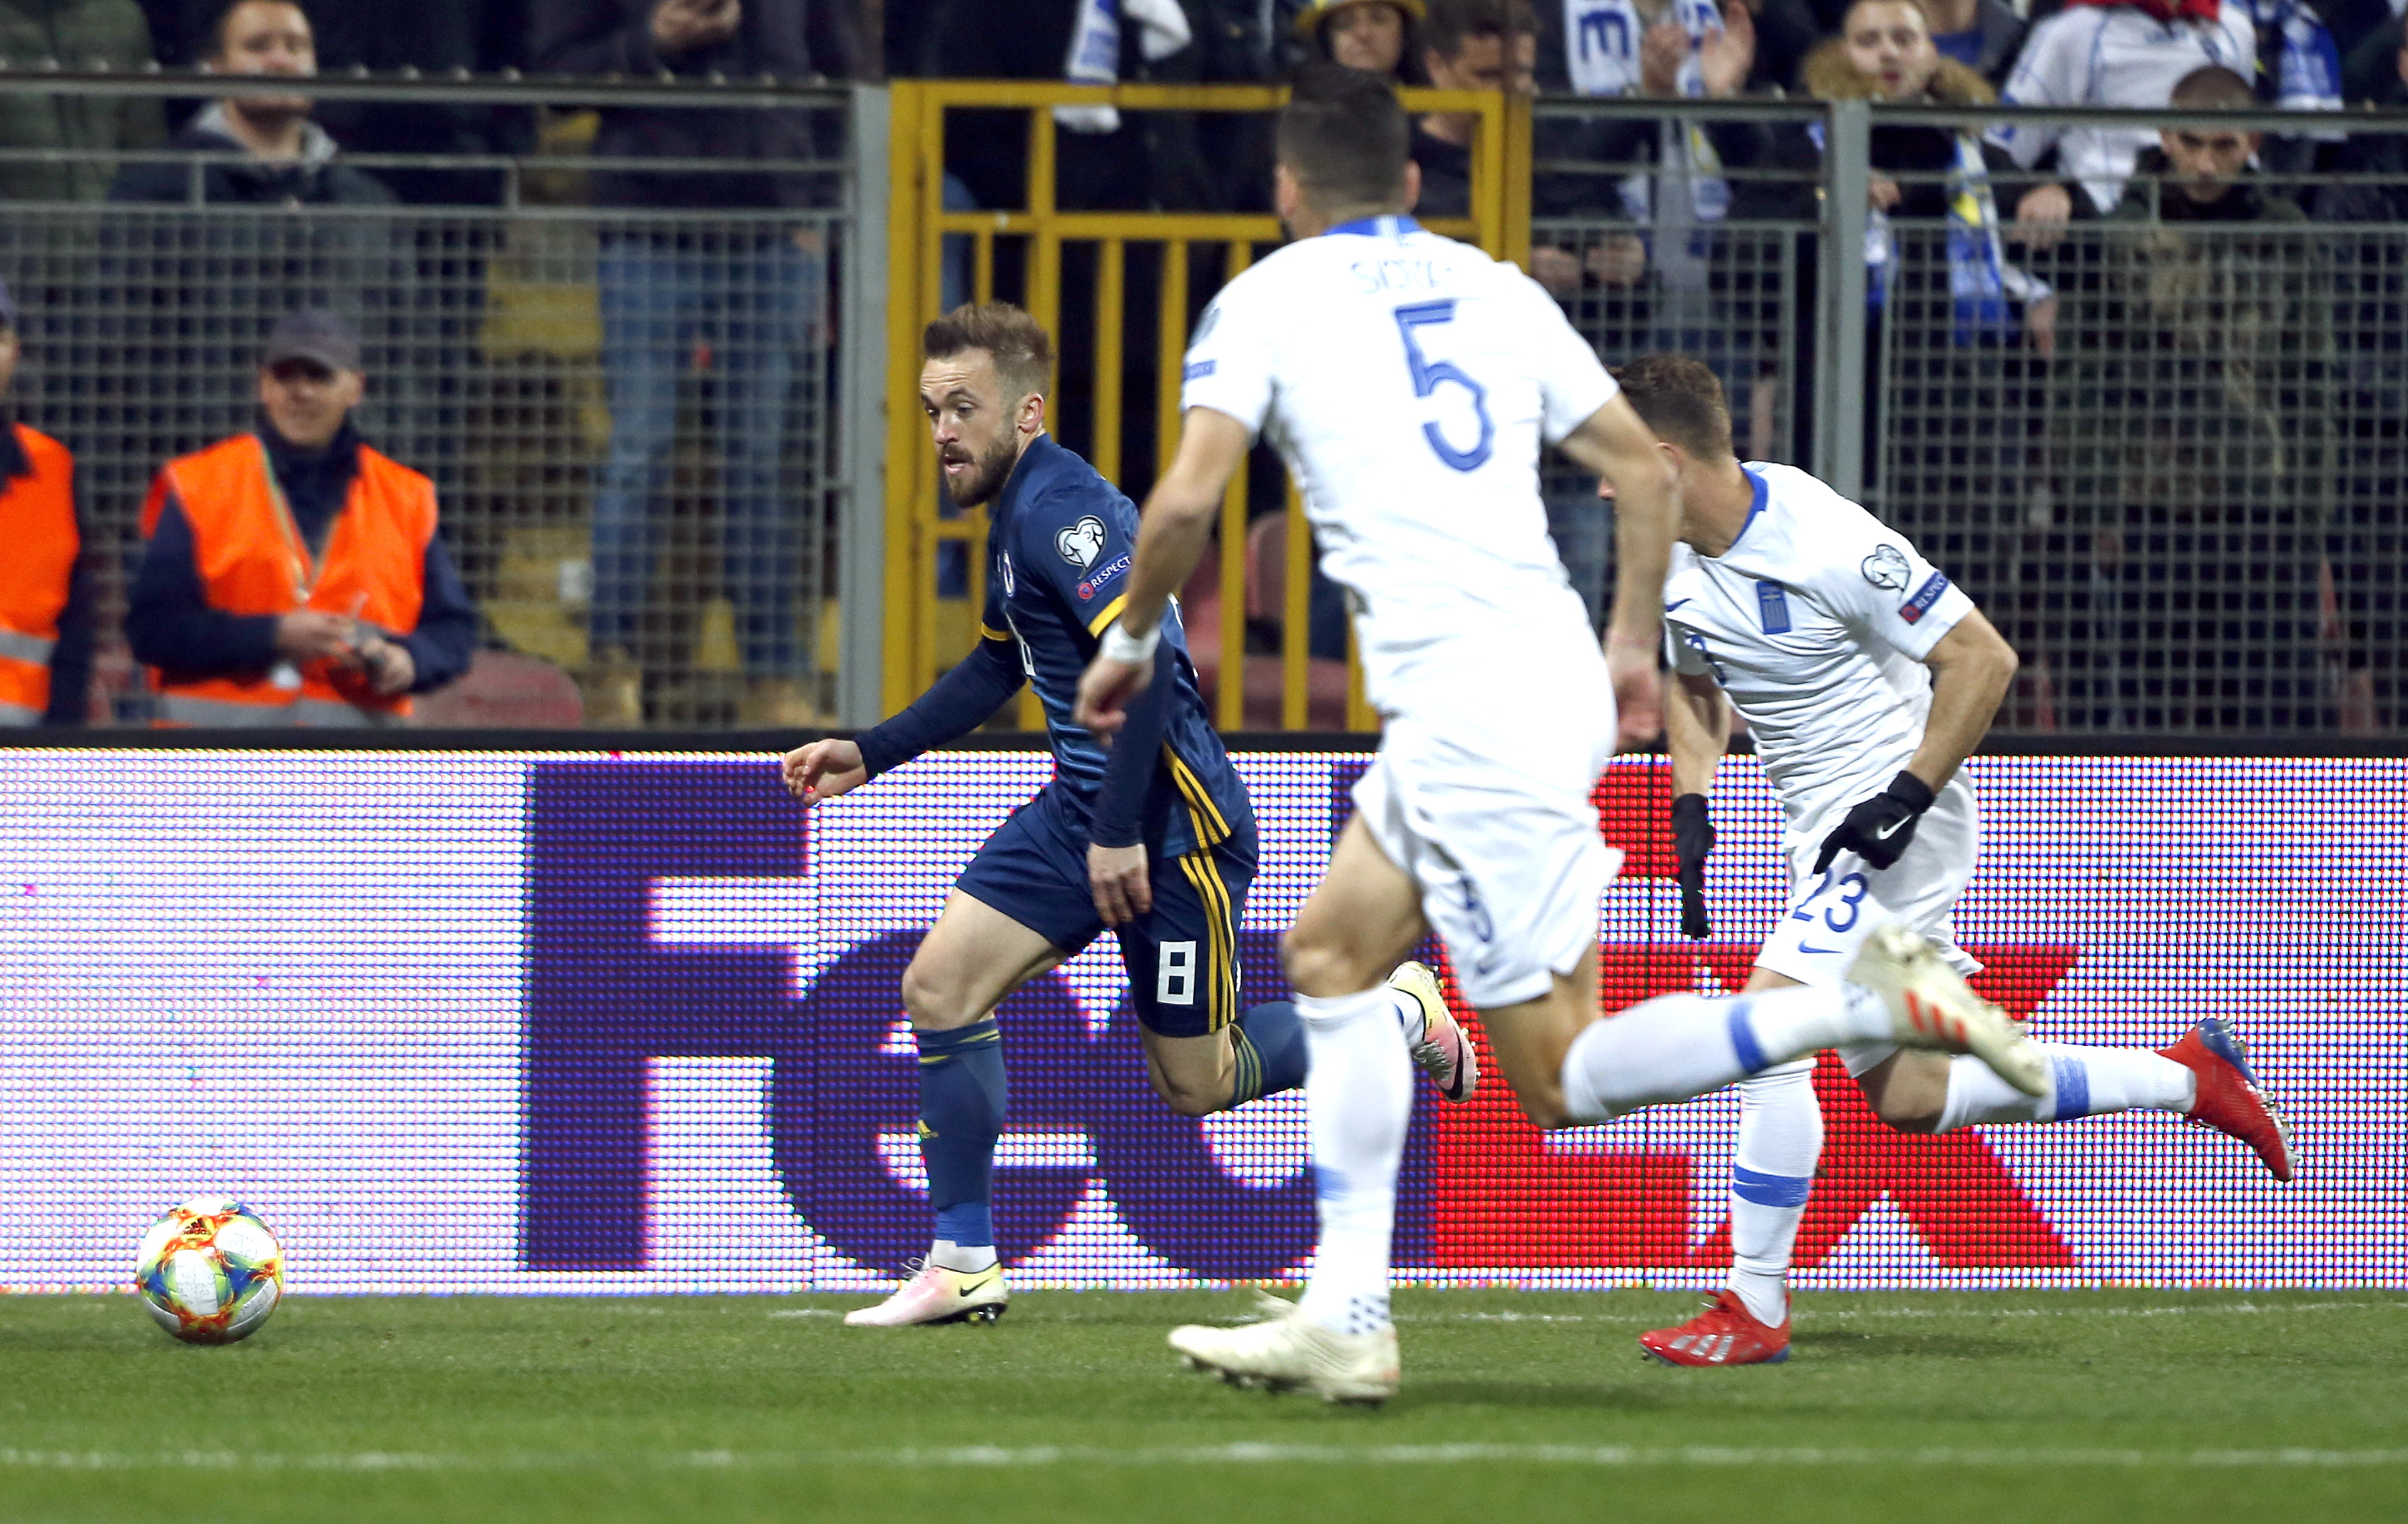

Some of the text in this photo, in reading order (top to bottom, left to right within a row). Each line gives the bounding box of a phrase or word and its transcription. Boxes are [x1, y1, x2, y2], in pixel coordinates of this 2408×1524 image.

[1394, 299, 1494, 472] 5
[1091, 556, 1131, 588] RESPECT
[1791, 865, 1867, 933] 23
[1157, 941, 1196, 1005] 8
